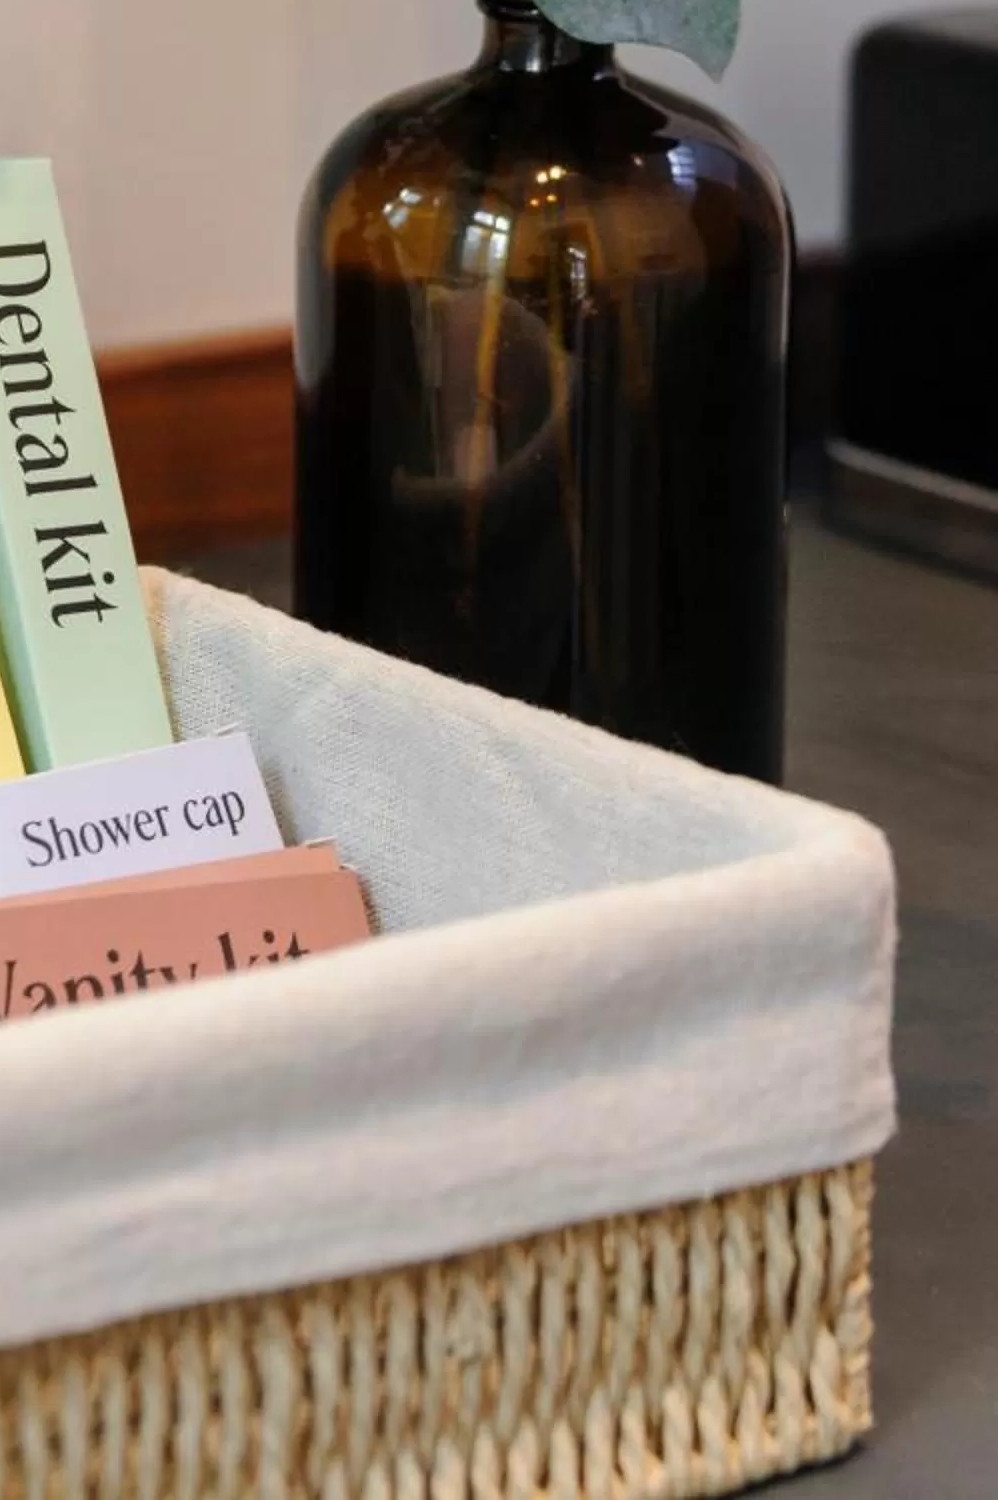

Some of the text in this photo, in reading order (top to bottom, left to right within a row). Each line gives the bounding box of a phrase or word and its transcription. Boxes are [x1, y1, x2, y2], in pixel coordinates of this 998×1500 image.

[34, 520, 118, 628] kit
[21, 791, 245, 867] Shower cap
